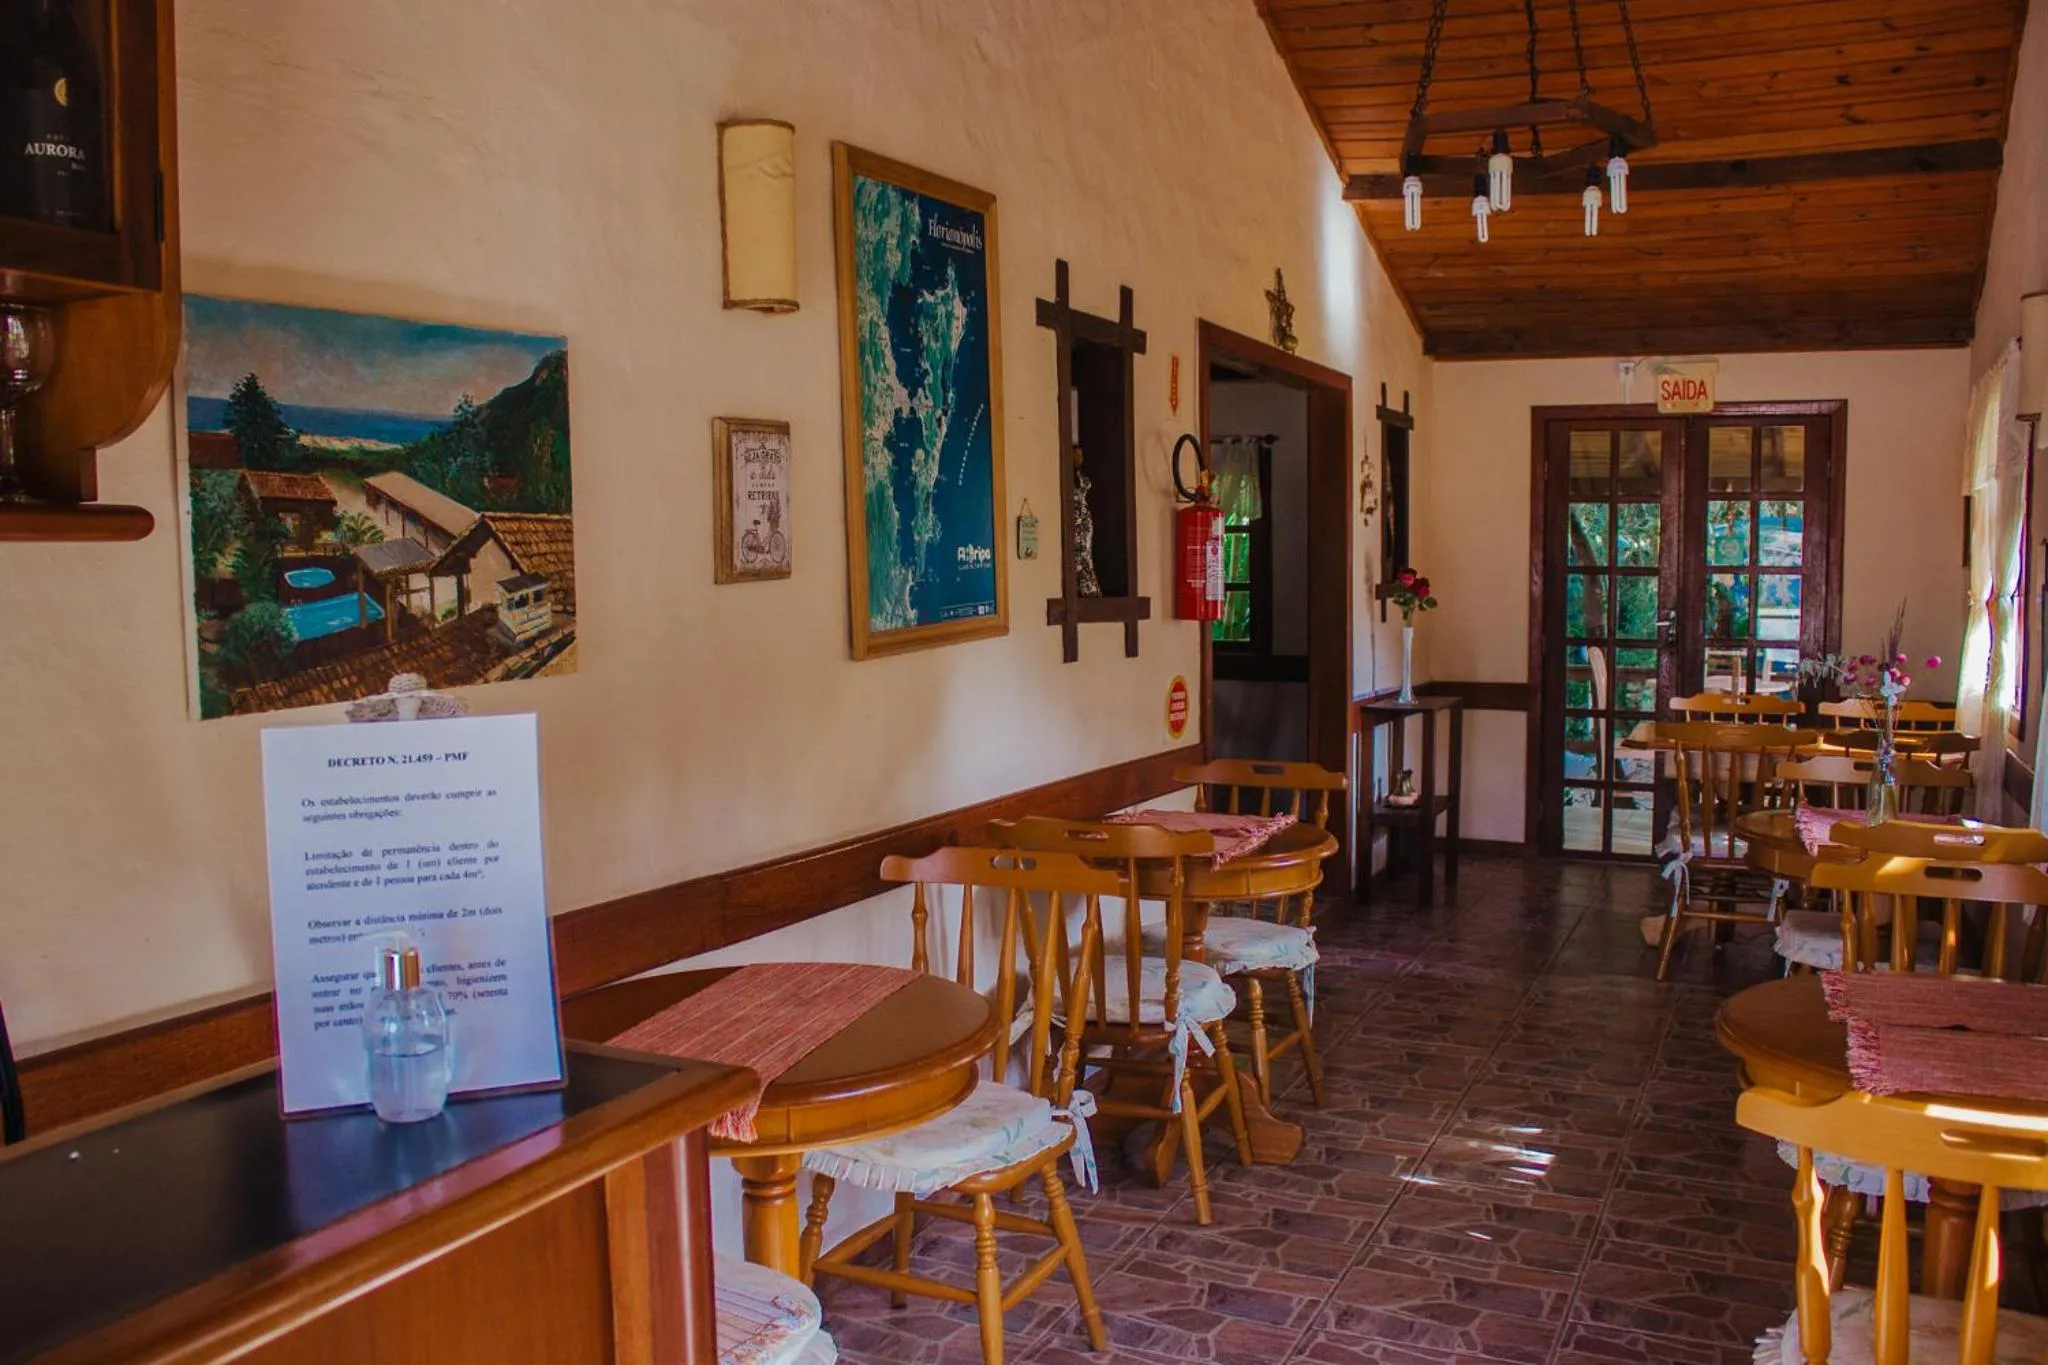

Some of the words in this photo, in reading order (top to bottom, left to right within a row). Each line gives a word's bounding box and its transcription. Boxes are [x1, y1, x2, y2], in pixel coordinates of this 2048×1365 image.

[23, 142, 86, 160] AURORA
[328, 756, 385, 768] DECRETO
[387, 755, 399, 765] N.
[402, 753, 433, 764] 21.459
[444, 751, 469, 762] PMF
[301, 798, 315, 808] Os
[320, 794, 400, 807] estabelecimentos
[404, 791, 441, 802] deverão
[445, 788, 482, 800] cumprir
[487, 789, 497, 797] as
[302, 811, 347, 824] seguintes
[304, 848, 352, 861] Limitação
[381, 844, 440, 858] permanência
[449, 841, 479, 851] dentro
[487, 840, 499, 849] do
[305, 863, 381, 876] estabelecimento
[386, 861, 399, 871] de
[418, 858, 441, 870] (um)
[447, 856, 478, 867] cliente
[484, 855, 500, 866] por
[306, 879, 351, 891] atendente
[361, 877, 374, 887] de
[417, 873, 437, 885] para
[439, 870, 460, 881] cada
[307, 919, 351, 930] Observar
[363, 912, 405, 925] distância
[408, 910, 444, 921] mínima
[446, 907, 459, 918] de
[461, 907, 476, 918] 2m
[309, 932, 346, 945] metros)
[311, 971, 360, 984] Assegurar
[467, 959, 491, 970] antes
[494, 957, 506, 968] de
[338, 1001, 364, 1013] mãos
[447, 990, 469, 1001] 70%
[349, 987, 362, 996] no
[313, 1020, 331, 1032] por
